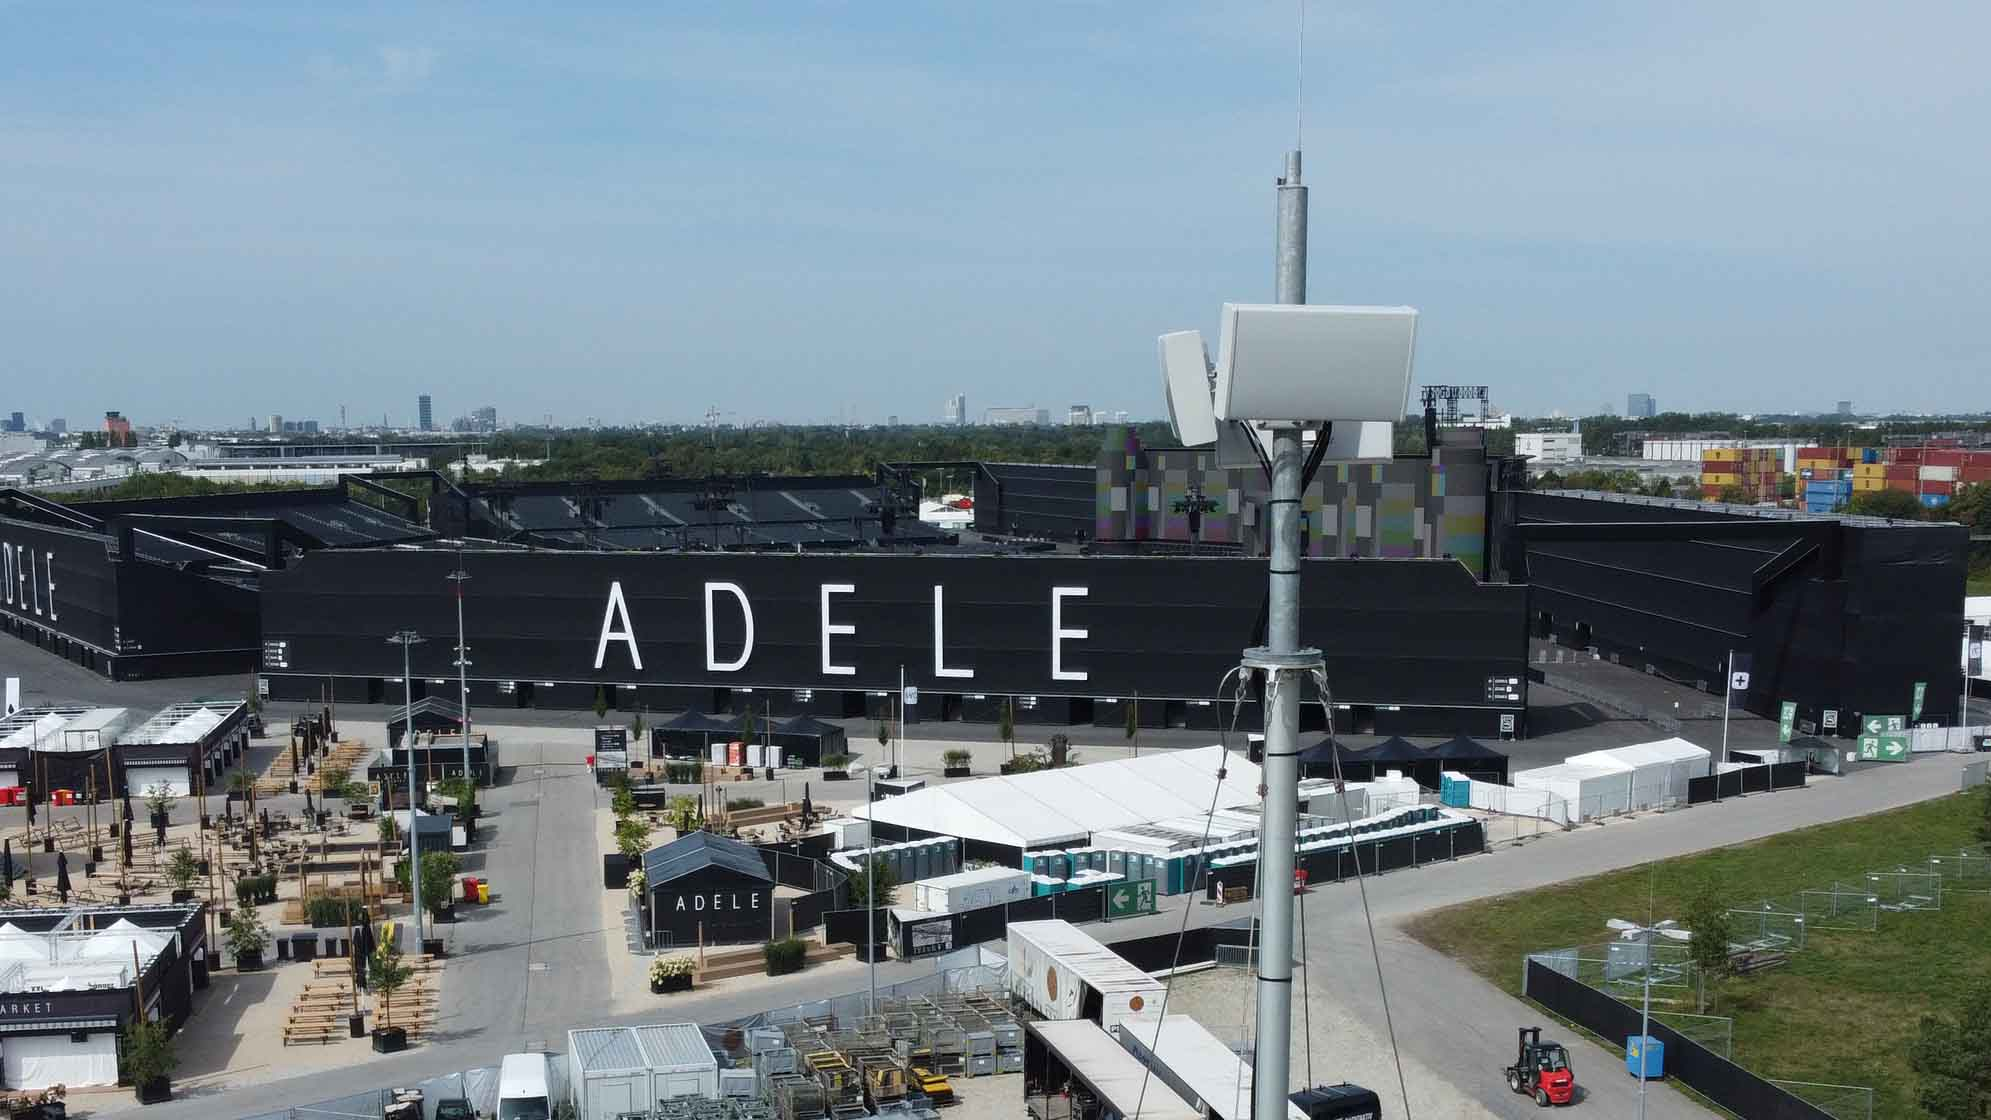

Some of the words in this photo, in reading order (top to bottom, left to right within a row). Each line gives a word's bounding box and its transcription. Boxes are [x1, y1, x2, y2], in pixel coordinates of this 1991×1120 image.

[0, 542, 57, 621] DELE
[594, 582, 1089, 680] ADELE
[676, 893, 759, 911] ADELE
